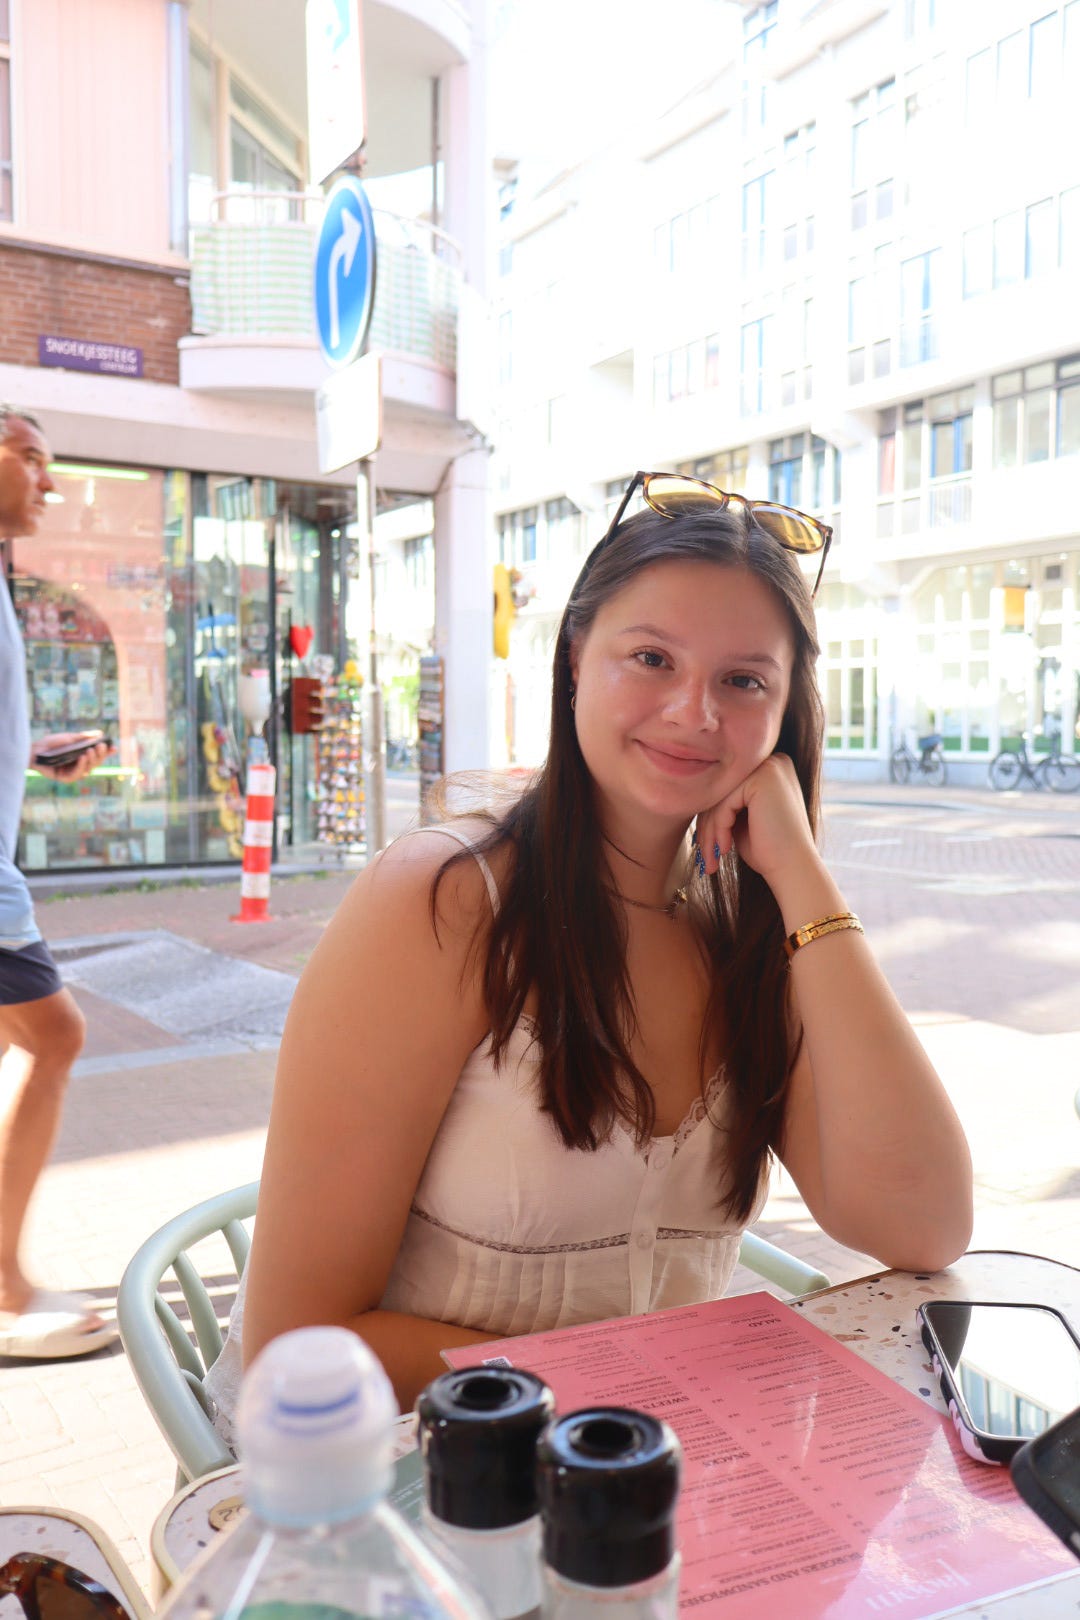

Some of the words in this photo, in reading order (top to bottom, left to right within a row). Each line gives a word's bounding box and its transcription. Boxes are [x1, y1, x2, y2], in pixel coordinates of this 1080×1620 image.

[746, 1318, 782, 1327] SALAD
[641, 1396, 690, 1409] SWEETS
[701, 1451, 751, 1466] SNACKS
[799, 1551, 863, 1573] BURGERS
[767, 1568, 803, 1582] AND
